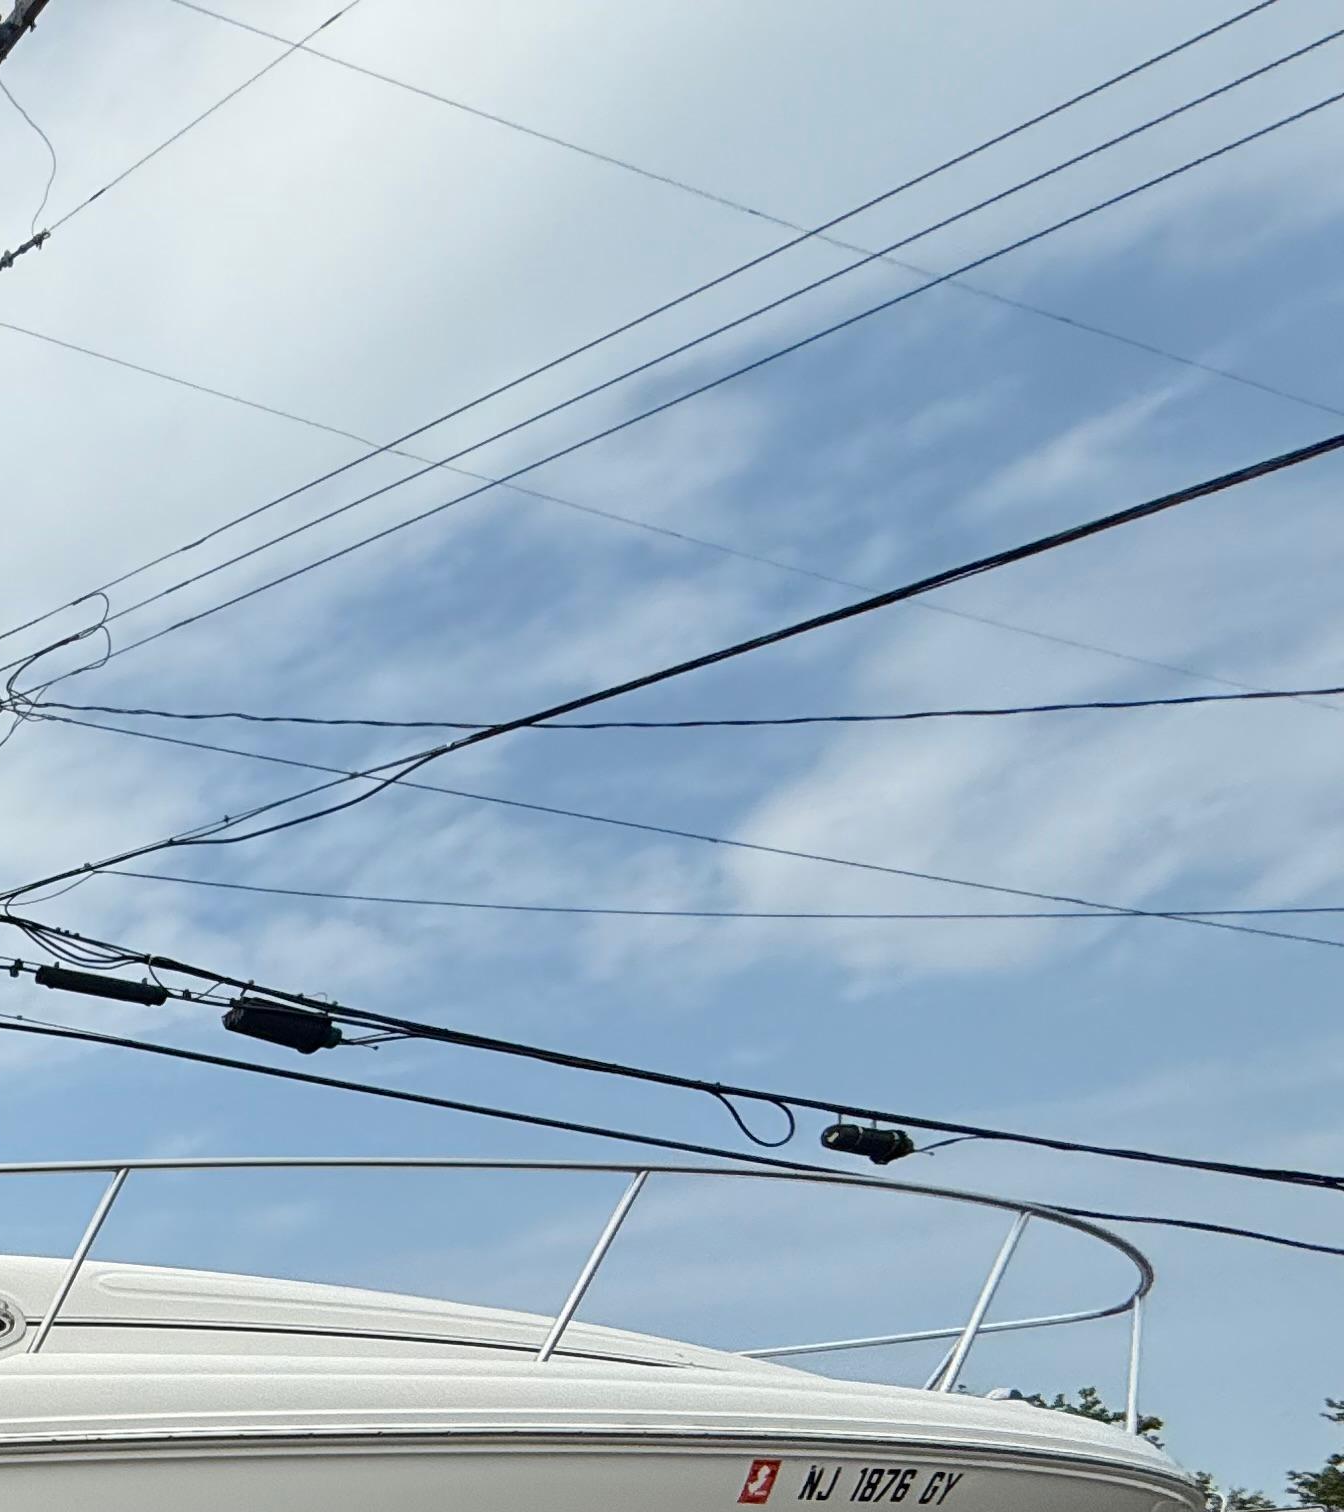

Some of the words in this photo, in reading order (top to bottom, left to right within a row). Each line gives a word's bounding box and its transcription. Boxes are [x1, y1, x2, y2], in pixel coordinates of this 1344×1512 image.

[798, 1464, 842, 1500] NJ
[850, 1467, 918, 1503] 1876
[918, 1471, 963, 1505] GY
